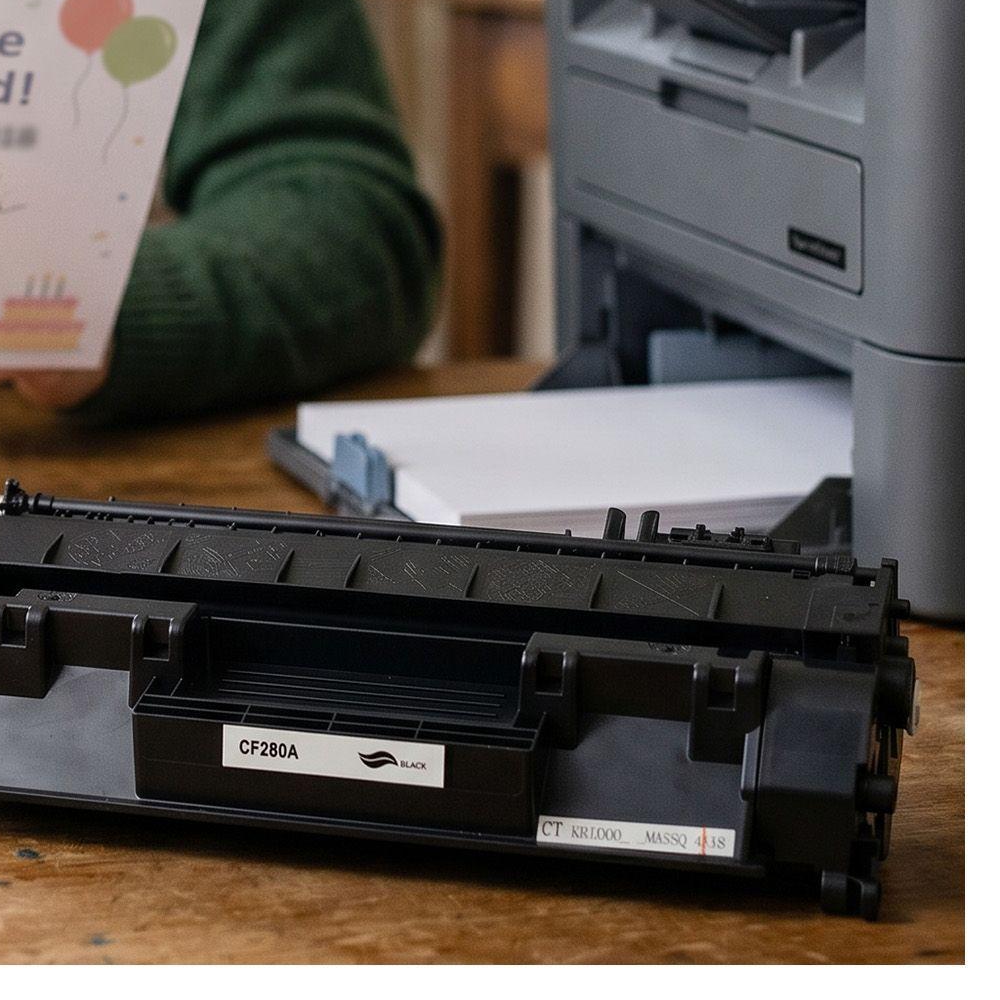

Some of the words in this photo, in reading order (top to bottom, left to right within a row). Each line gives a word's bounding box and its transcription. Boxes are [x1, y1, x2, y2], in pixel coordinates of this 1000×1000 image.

[239, 739, 299, 760] CF280A
[400, 760, 427, 770] BLACK
[542, 820, 563, 837] CT
